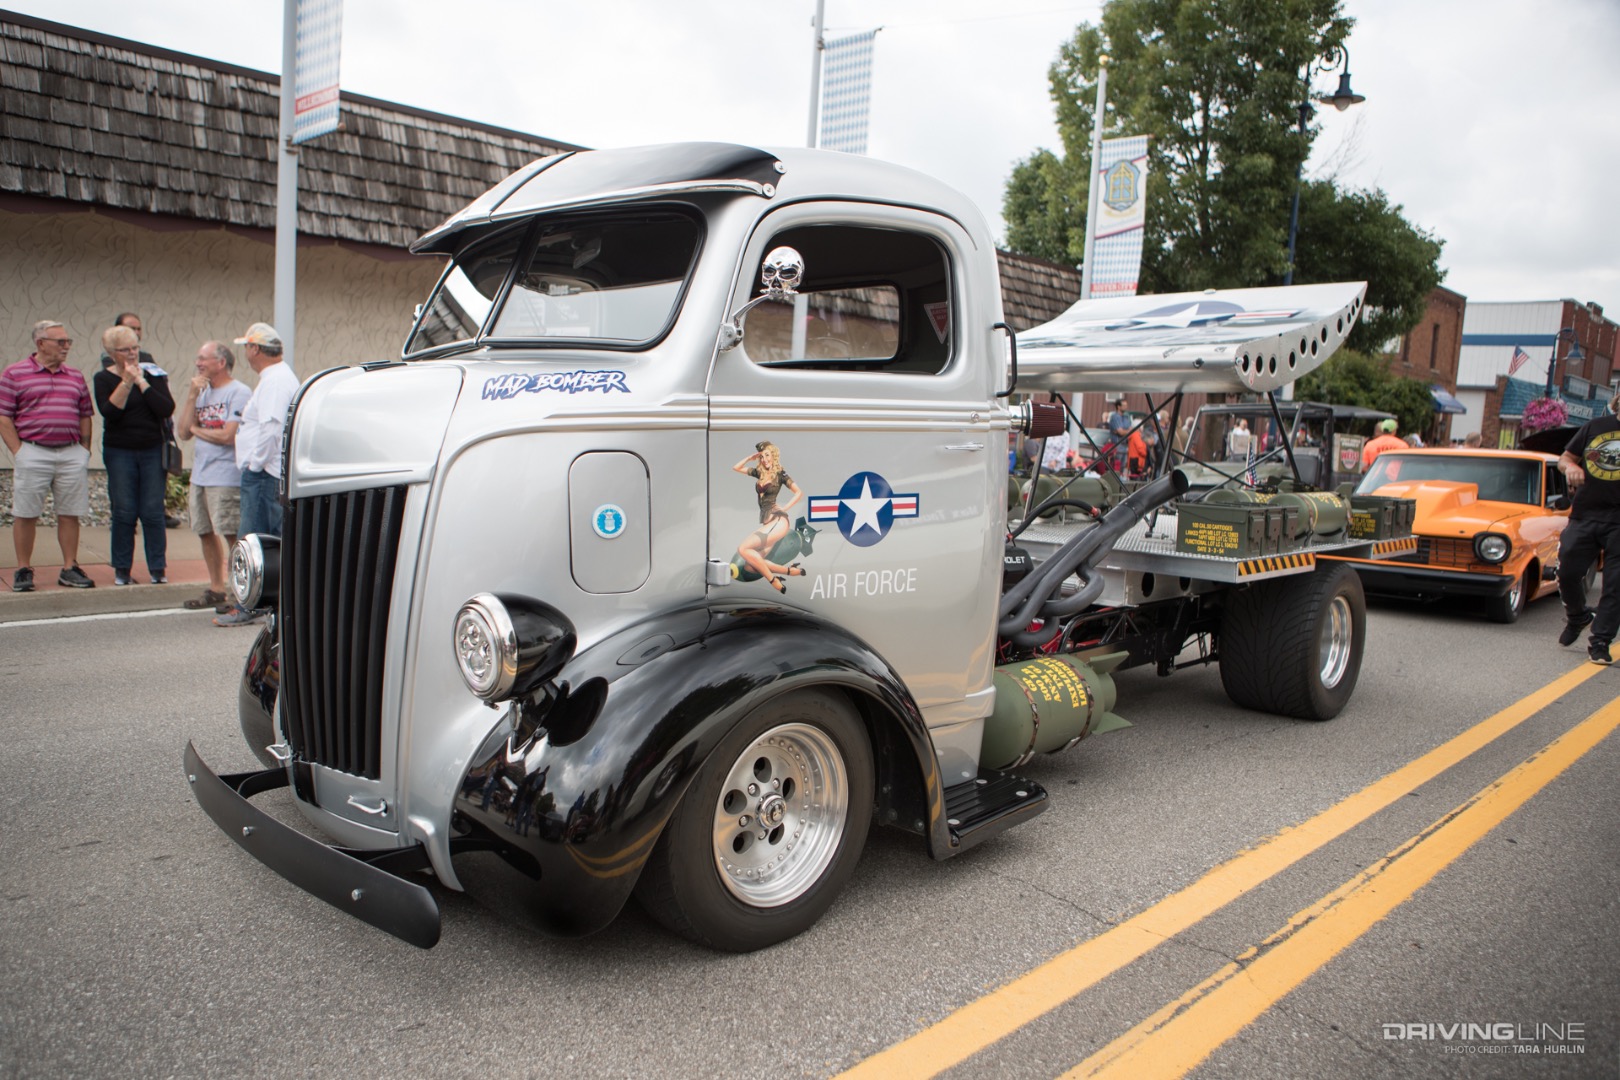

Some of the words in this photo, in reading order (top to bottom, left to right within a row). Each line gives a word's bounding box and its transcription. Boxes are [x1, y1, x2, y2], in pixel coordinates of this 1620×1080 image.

[482, 374, 530, 401] MAD
[533, 370, 631, 394] BOMBER
[810, 574, 847, 600] AIR
[854, 568, 917, 597] FORCE
[1035, 679, 1052, 701] 500
